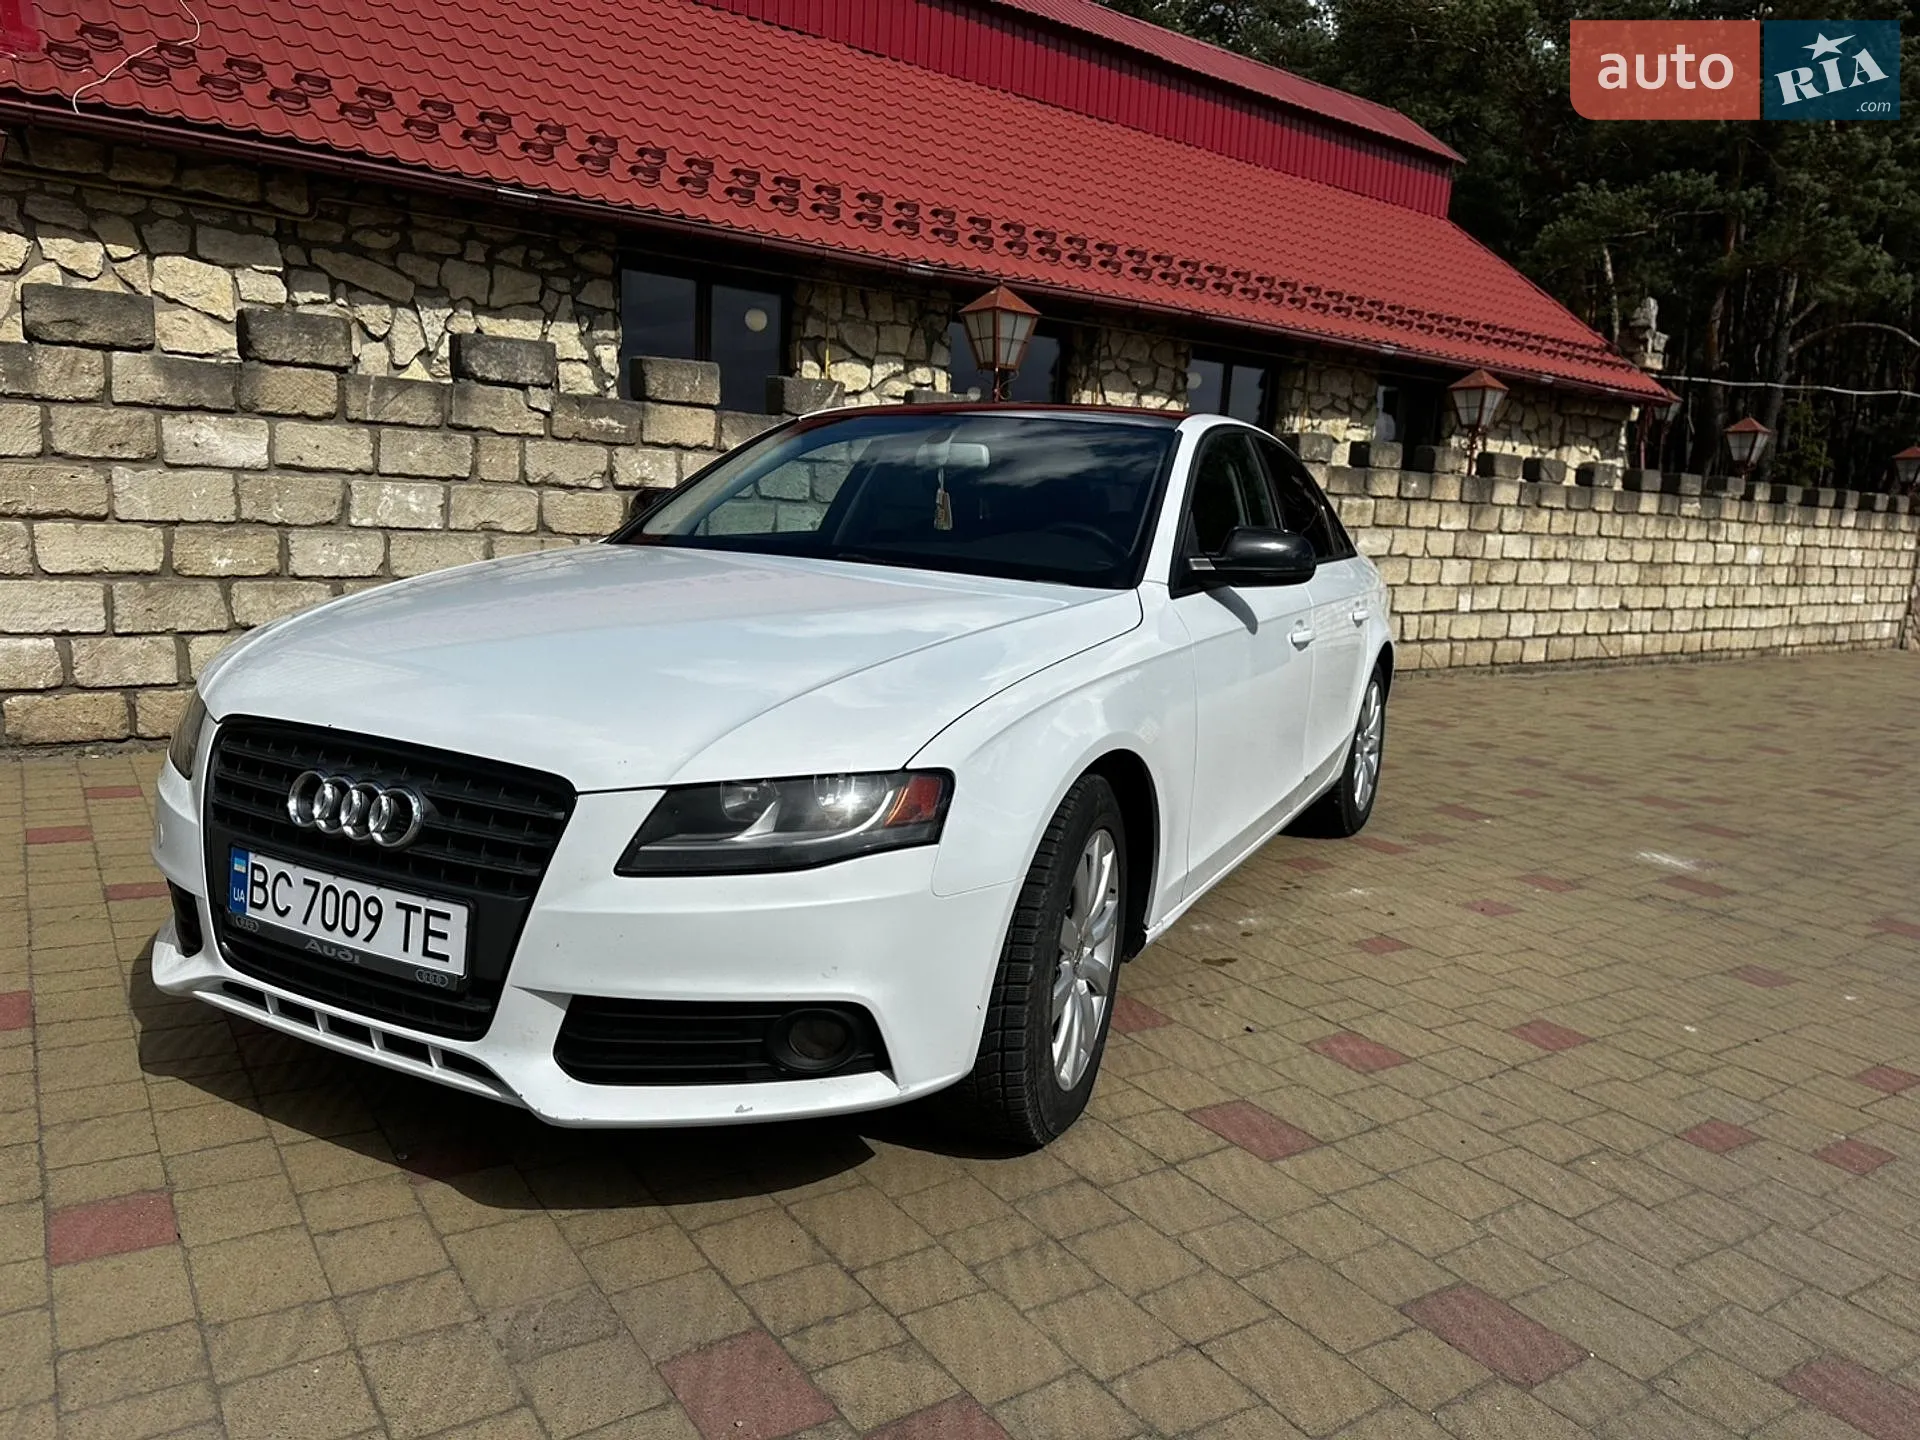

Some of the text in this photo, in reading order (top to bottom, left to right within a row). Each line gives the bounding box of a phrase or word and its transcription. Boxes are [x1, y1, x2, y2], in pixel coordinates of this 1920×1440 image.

[233, 887, 245, 903] UA
[251, 862, 451, 963] BC 7009 TE
